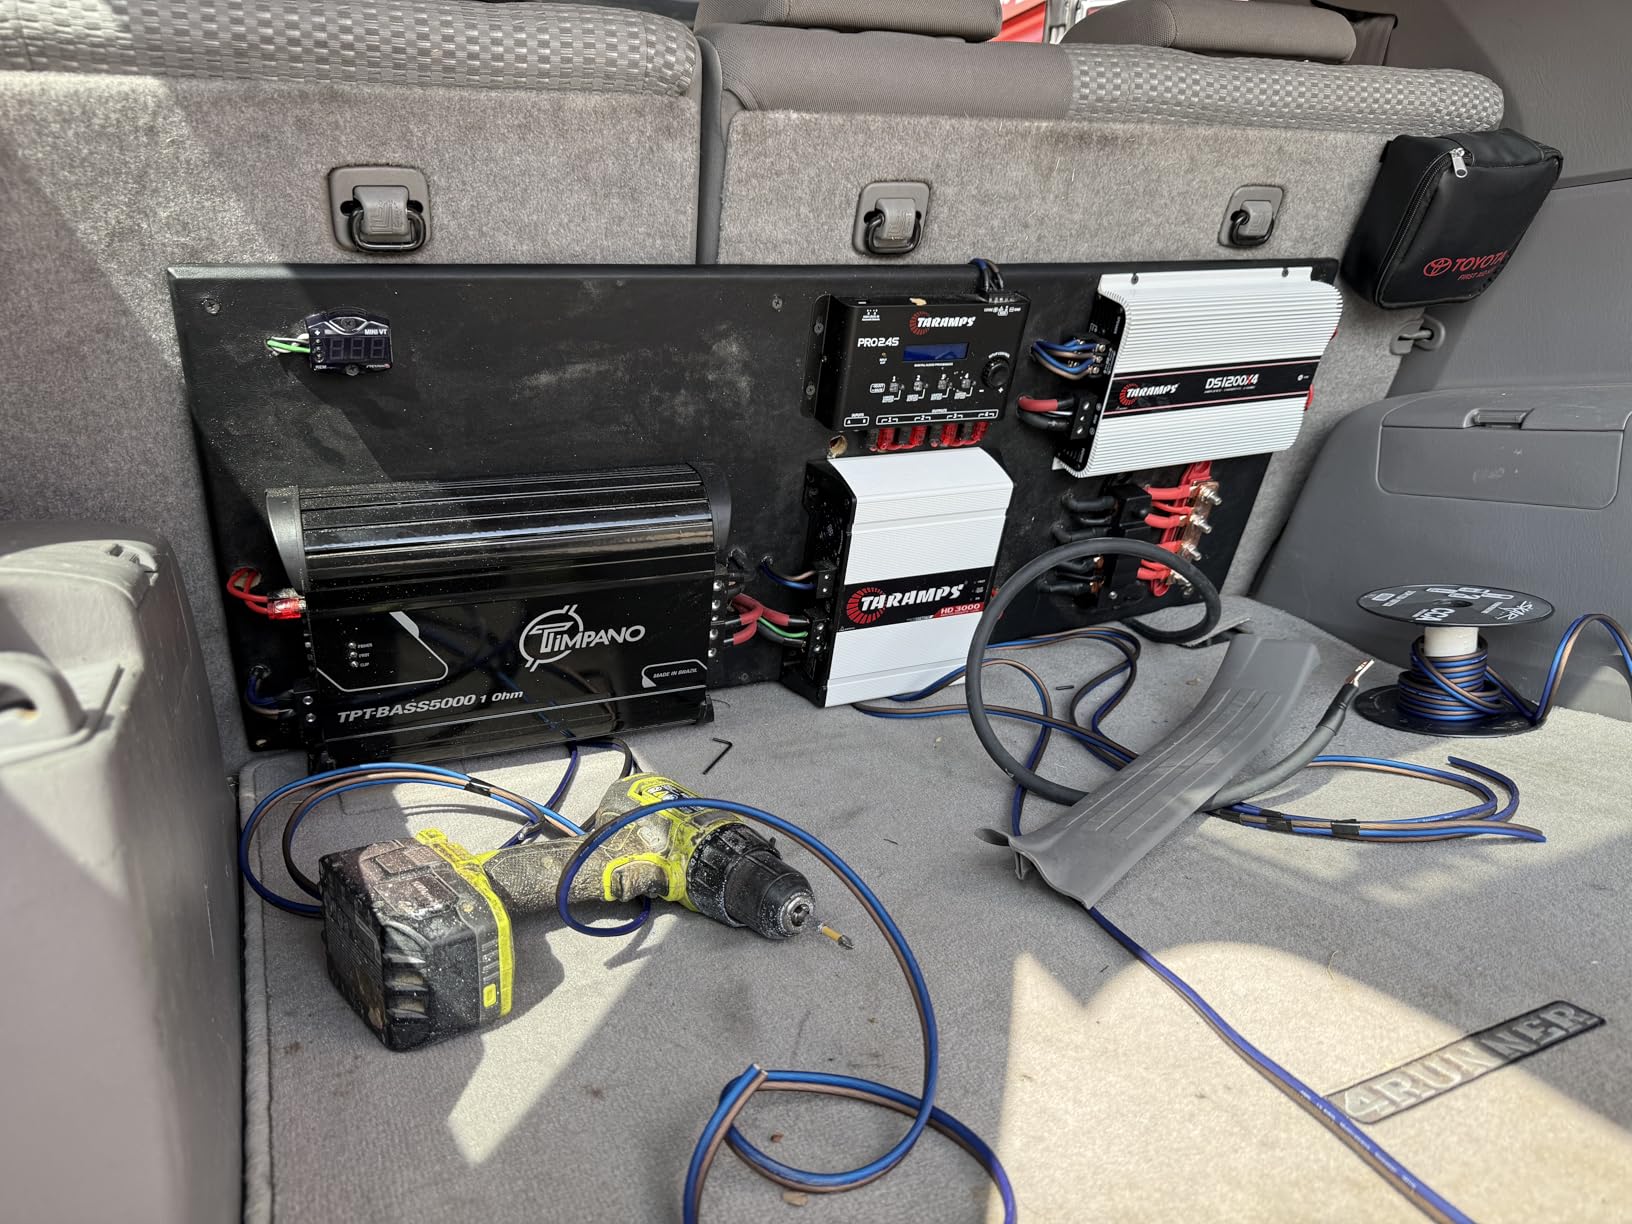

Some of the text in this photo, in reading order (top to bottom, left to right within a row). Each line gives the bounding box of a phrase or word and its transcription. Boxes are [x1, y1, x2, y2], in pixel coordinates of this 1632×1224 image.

[1451, 249, 1509, 272] TOYOTA
[917, 316, 976, 328] TARAMPS
[1126, 382, 1180, 398] TARAMPS
[861, 584, 964, 612] TARAMPS
[940, 603, 980, 614] HD 3000
[337, 691, 524, 723] TPT-BASS5000 1 Ohm
[1344, 1005, 1599, 1117] 4RUNNER
